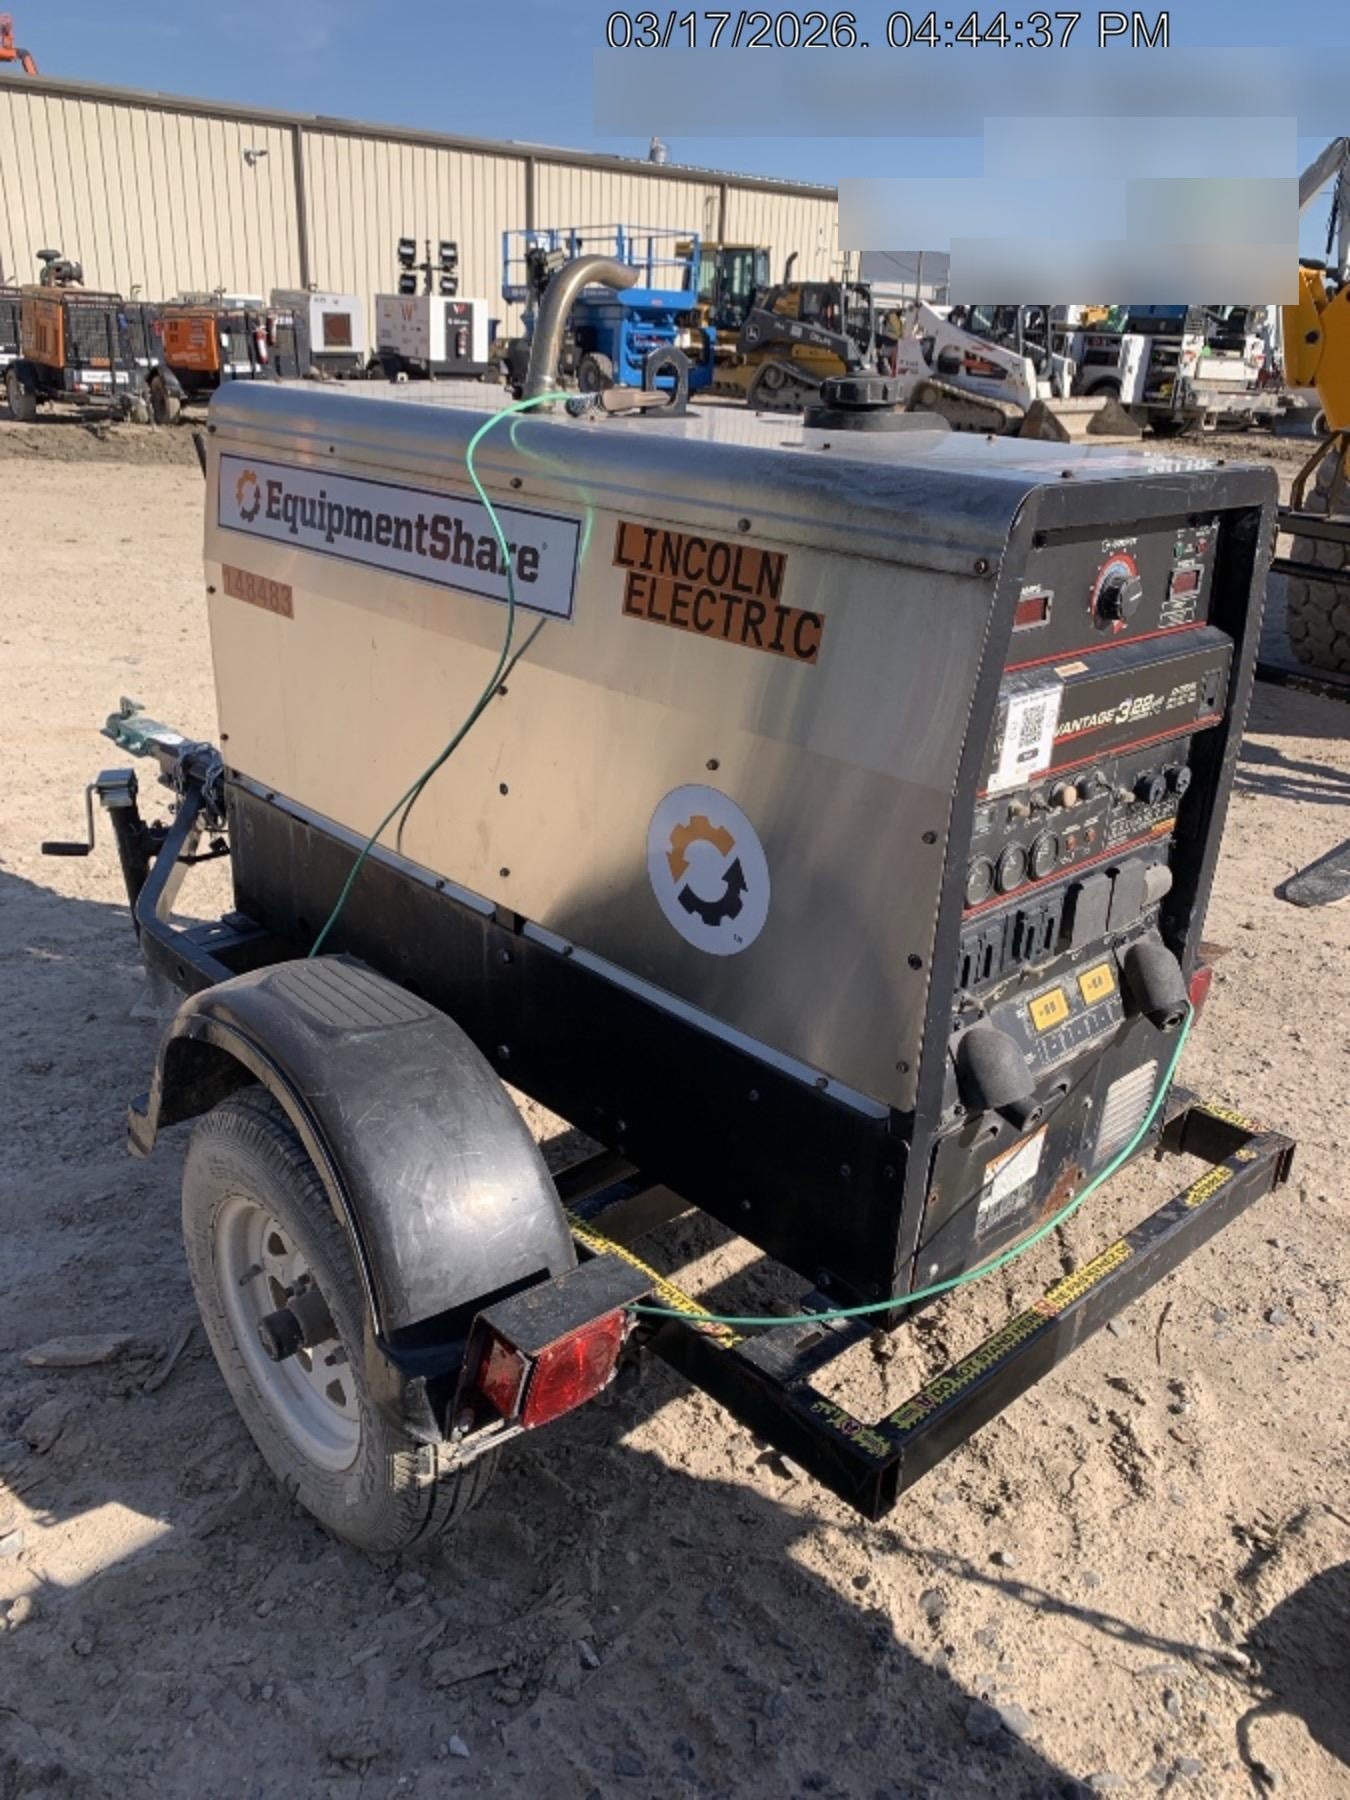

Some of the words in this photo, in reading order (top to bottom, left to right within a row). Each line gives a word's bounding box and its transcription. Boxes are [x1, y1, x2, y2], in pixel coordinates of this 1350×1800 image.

[265, 480, 540, 583] EquipmentShare
[616, 522, 785, 599] LINCOLN
[625, 572, 821, 658] ELECTRIC
[931, 1380, 953, 1398] DO
[976, 1332, 1013, 1363] STAND
